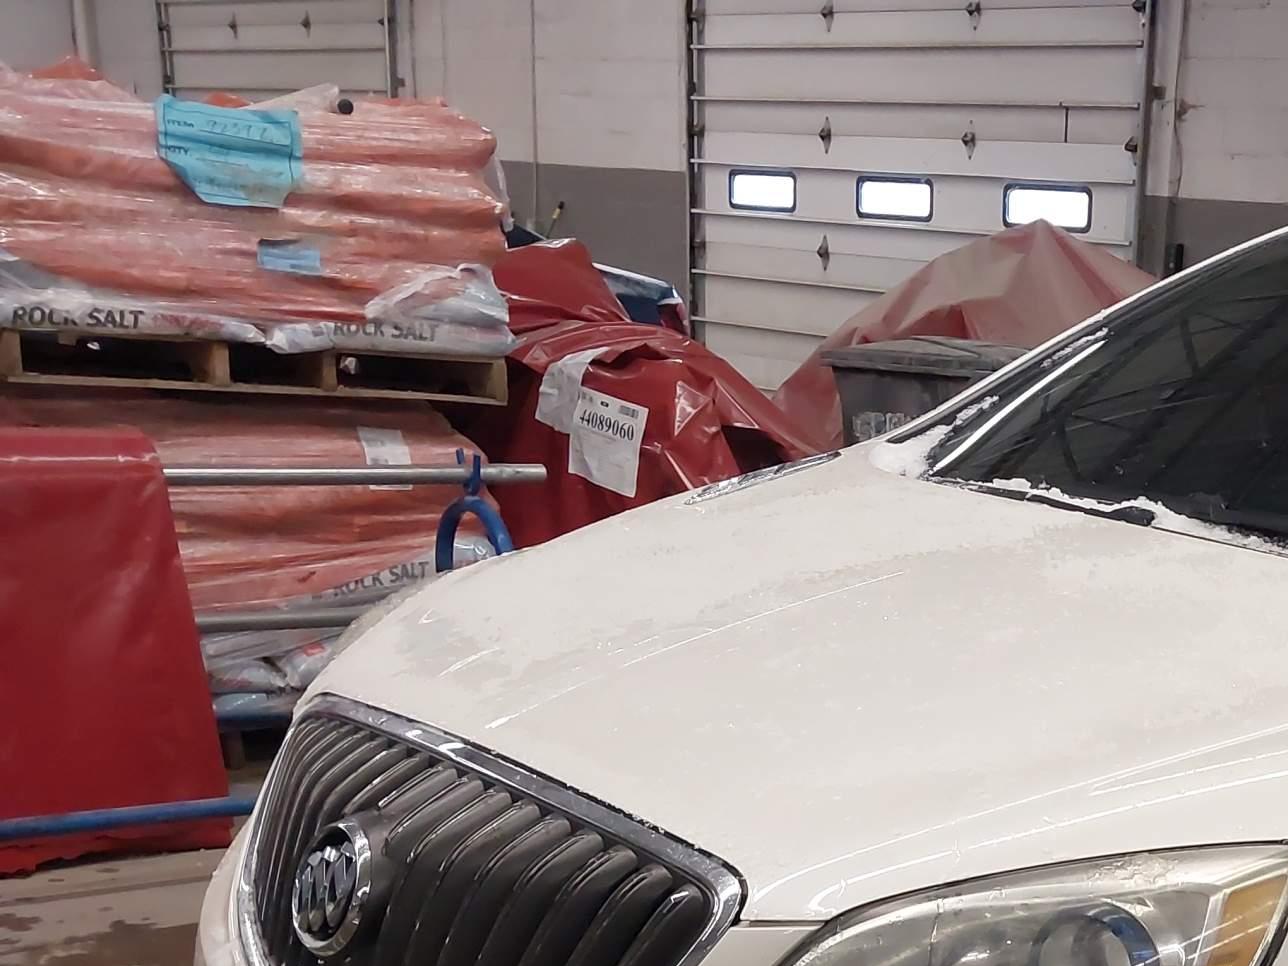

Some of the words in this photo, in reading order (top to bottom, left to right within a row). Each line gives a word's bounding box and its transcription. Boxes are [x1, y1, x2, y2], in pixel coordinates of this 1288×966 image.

[86, 307, 145, 329] SALT
[391, 322, 441, 342] SALT
[579, 408, 635, 441] 44089060
[390, 561, 430, 584] SALT
